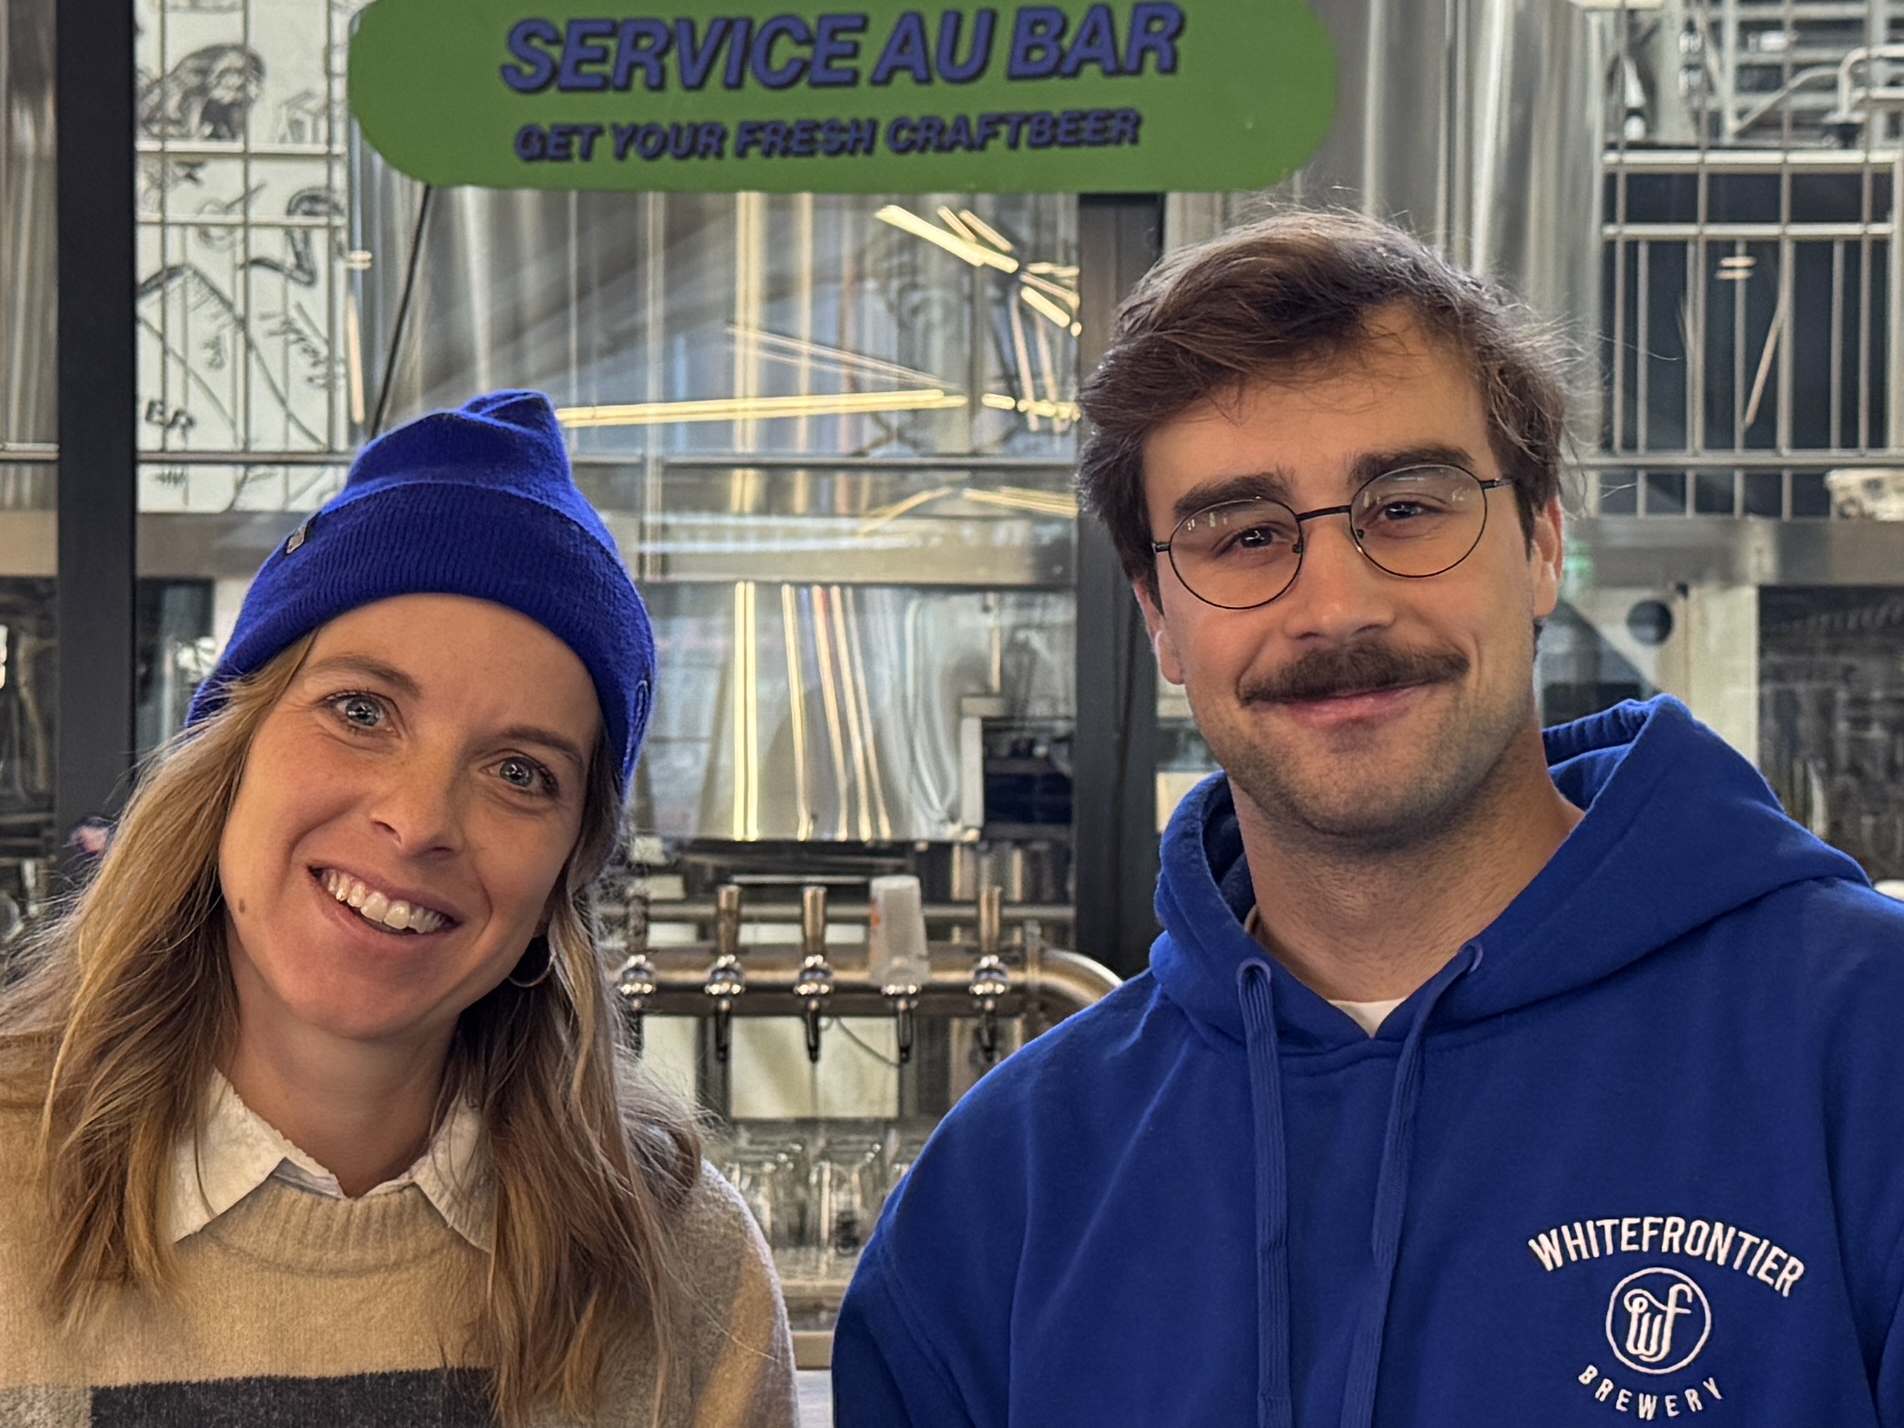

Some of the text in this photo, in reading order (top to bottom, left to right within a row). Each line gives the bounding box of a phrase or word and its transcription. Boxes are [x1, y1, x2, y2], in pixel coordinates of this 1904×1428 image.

[500, 0, 1185, 94] SERVICE AU BAR
[512, 108, 1142, 162] GET YOUR FRESH CRAFTBEER
[1527, 1216, 1806, 1298] WHITEFRONTIER
[1578, 1364, 1724, 1422] BREWERY
